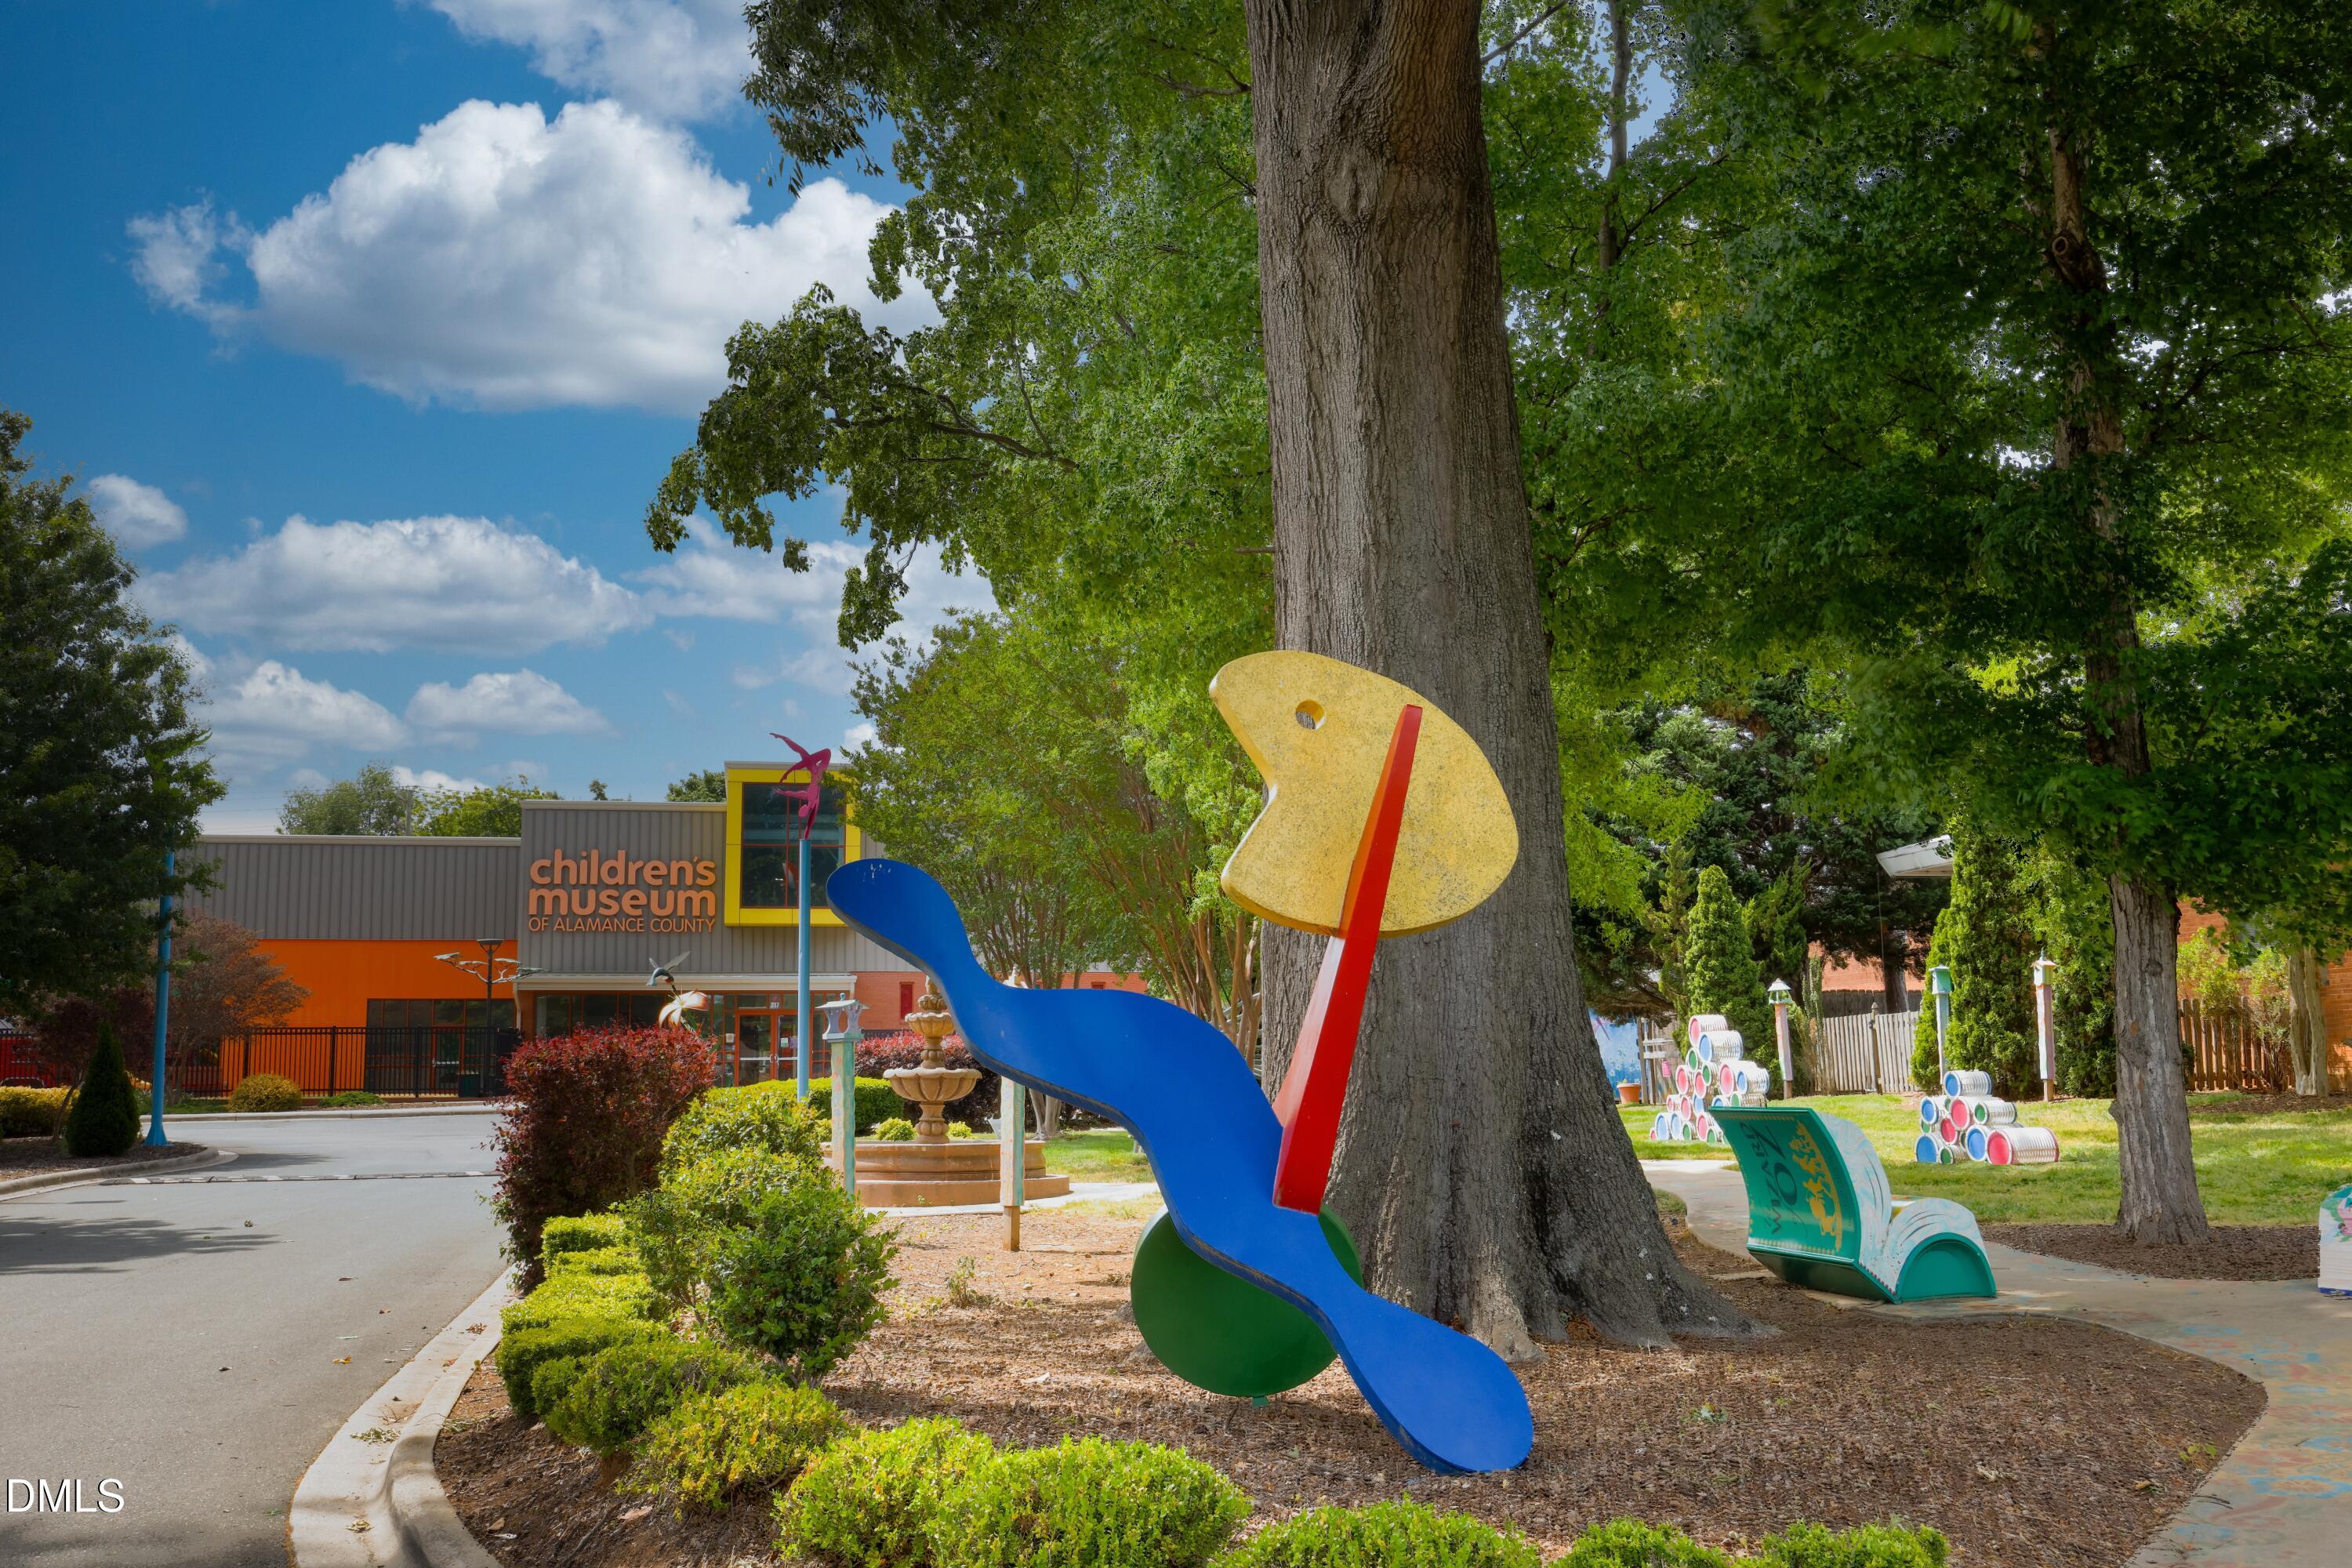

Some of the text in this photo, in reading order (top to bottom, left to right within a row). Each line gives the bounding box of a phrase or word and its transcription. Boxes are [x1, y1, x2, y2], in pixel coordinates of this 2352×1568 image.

[529, 848, 716, 886] children's
[528, 888, 716, 916] museum
[528, 917, 715, 933] OF ALAMANCE COUNTY
